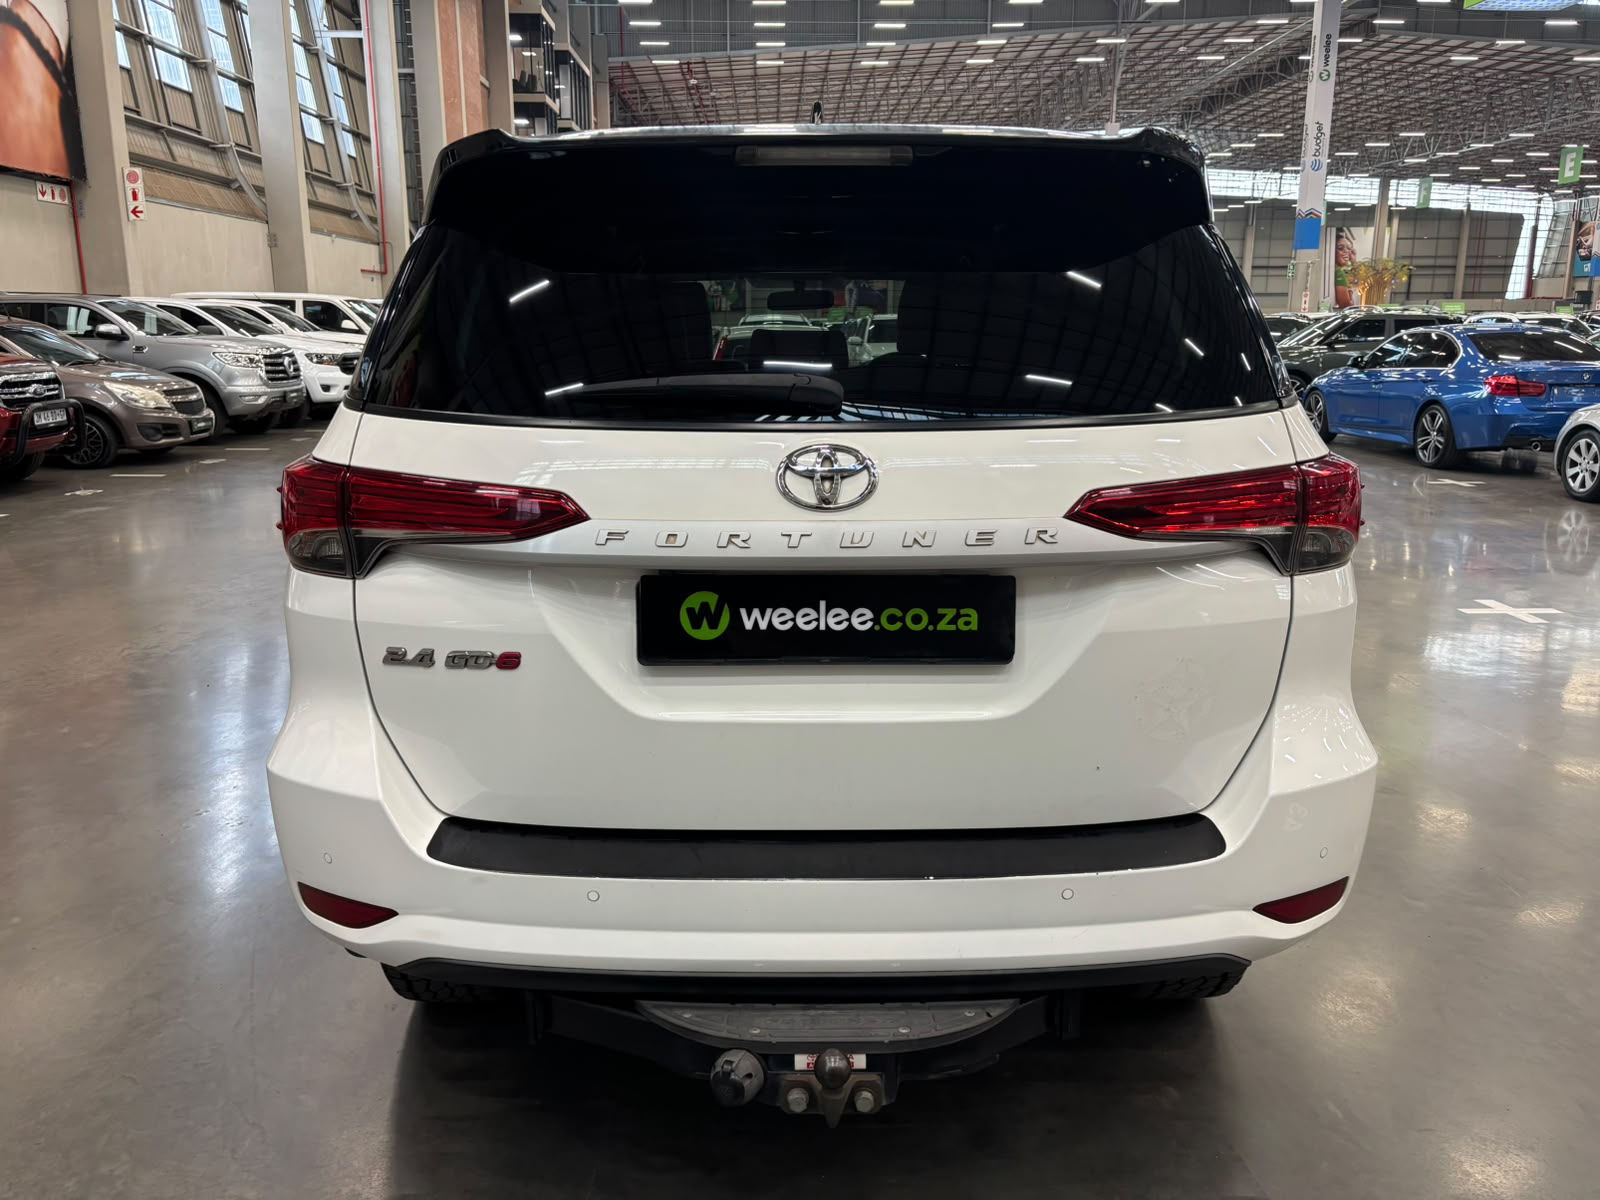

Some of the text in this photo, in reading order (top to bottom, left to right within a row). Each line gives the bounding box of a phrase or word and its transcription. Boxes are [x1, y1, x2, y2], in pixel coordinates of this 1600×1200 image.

[1323, 33, 1332, 67] weelee
[1312, 121, 1325, 157] budget
[1564, 152, 1576, 177] E
[595, 527, 1060, 549] FORTUNER
[739, 600, 978, 632] weelee.co.za
[444, 650, 522, 670] GD-6
